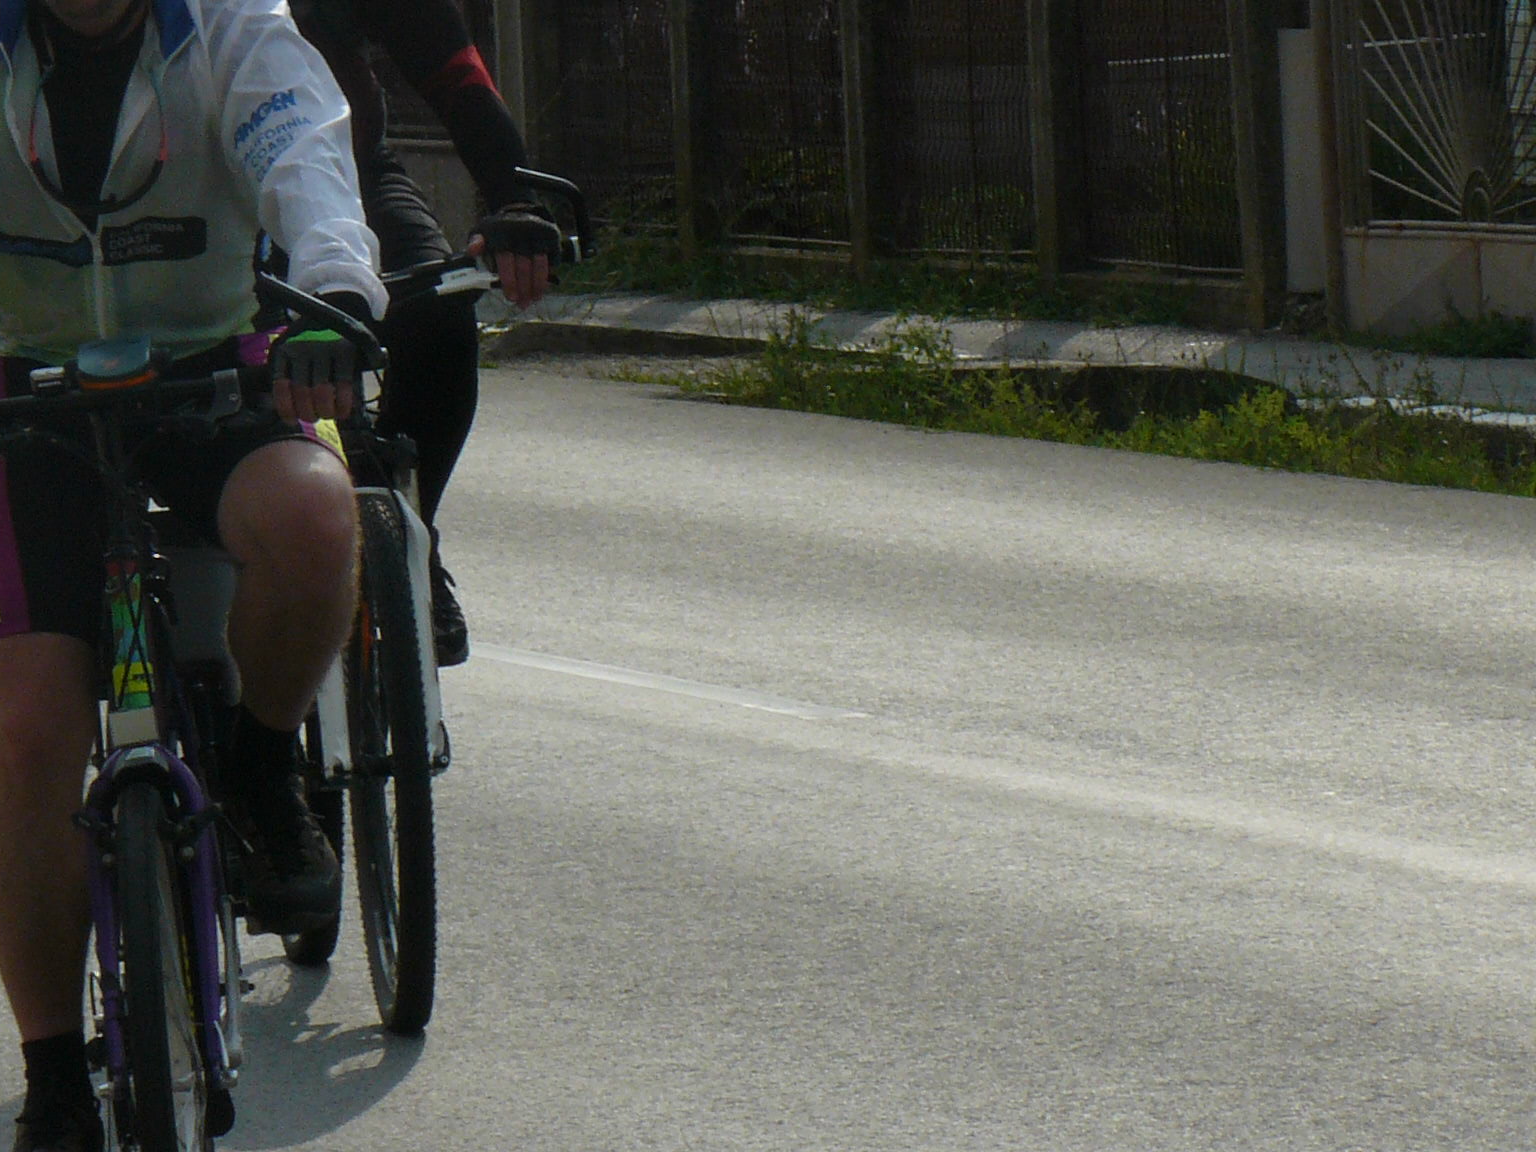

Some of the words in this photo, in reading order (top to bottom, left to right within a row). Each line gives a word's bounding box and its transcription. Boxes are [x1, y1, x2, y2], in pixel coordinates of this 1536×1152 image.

[234, 89, 296, 149] AMGEN
[251, 133, 294, 168] COAST
[109, 233, 152, 250] COAST
